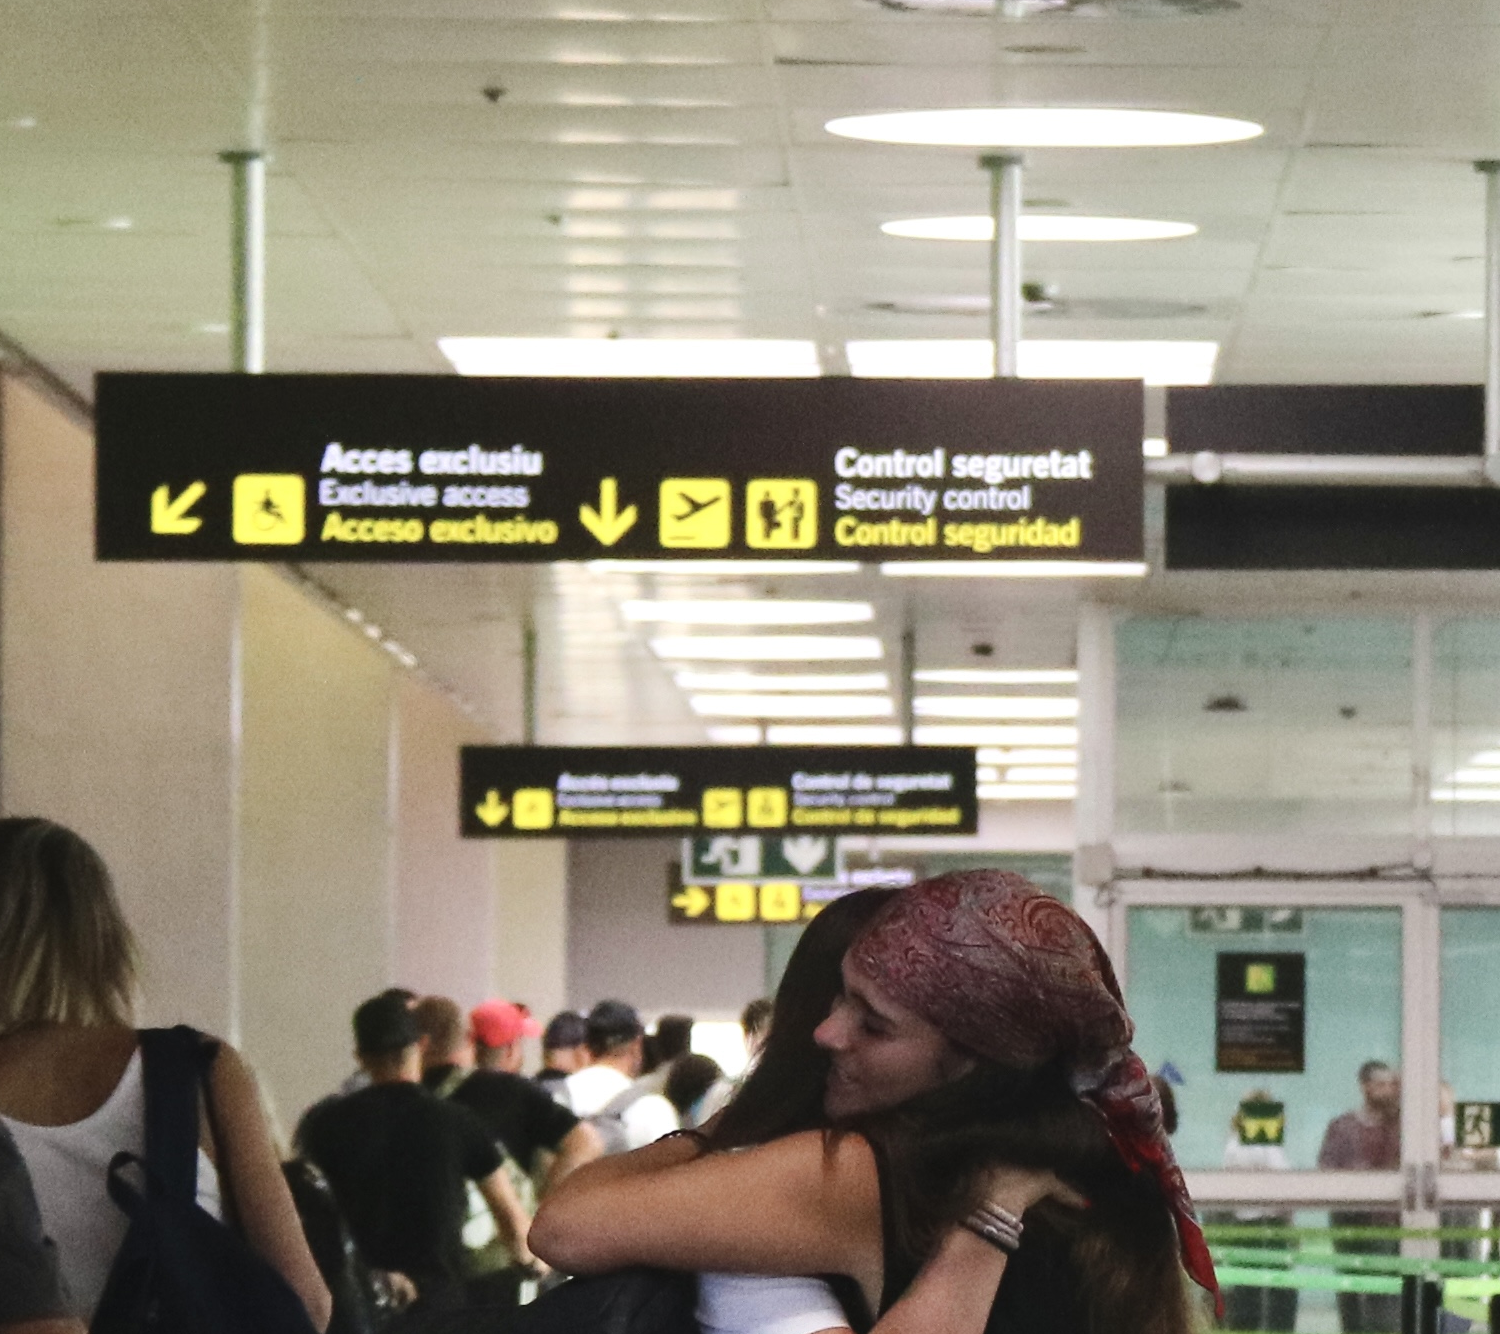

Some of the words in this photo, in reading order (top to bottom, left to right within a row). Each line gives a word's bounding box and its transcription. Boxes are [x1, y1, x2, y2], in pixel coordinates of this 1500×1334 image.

[418, 443, 545, 476] exclusiu
[834, 447, 945, 479] Control
[951, 449, 1093, 485] seguretat
[319, 479, 439, 507] Exclusive
[441, 485, 531, 508] access
[834, 482, 938, 516] Security
[942, 483, 1032, 511] control
[320, 511, 425, 543] Acceso
[428, 513, 560, 545] exclusivo
[834, 515, 938, 547] Control
[943, 517, 1082, 553] seguridad
